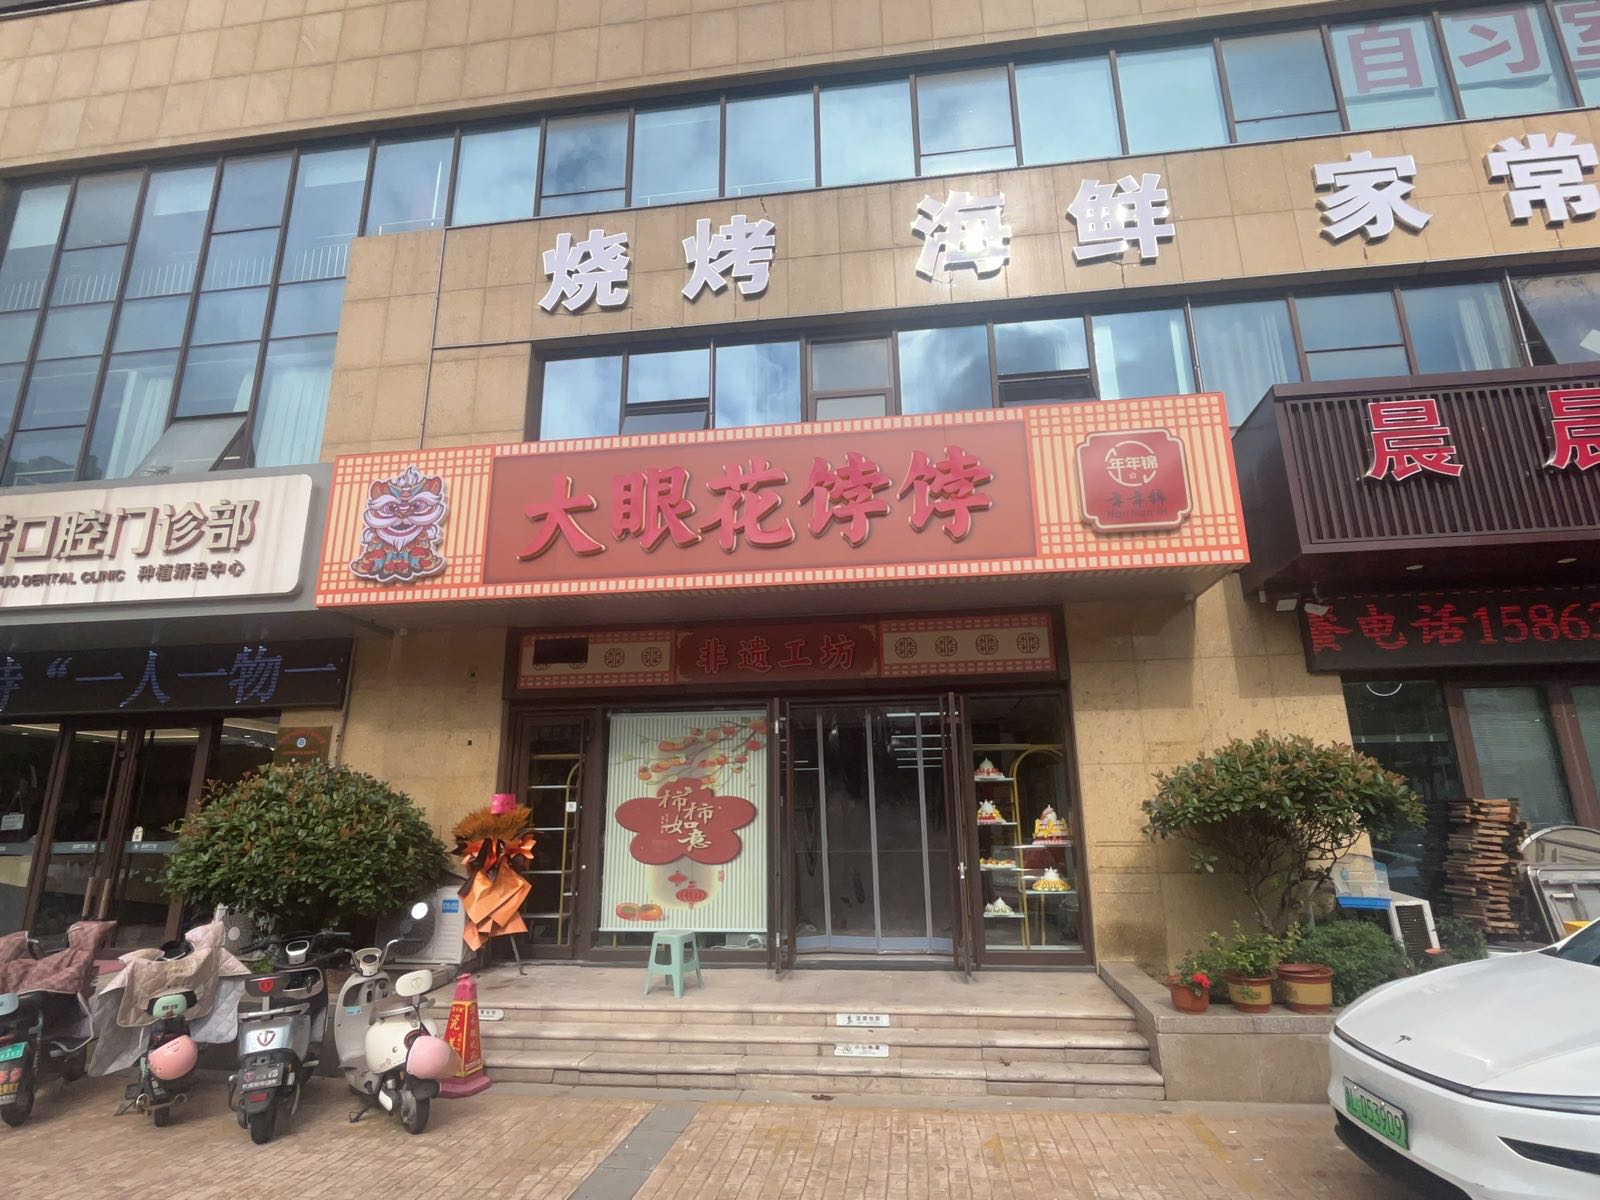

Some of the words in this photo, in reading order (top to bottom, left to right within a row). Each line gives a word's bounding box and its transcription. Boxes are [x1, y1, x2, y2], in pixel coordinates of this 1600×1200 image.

[538, 214, 776, 312] 烧烤
[910, 172, 1177, 280] 海鲜
[1311, 131, 1600, 243] 家常
[516, 444, 995, 561] 大眼花饽饽
[21, 572, 77, 588] DENTAL
[81, 569, 126, 584] CLINIC
[137, 559, 245, 583] 种植矫治中心
[696, 633, 856, 674] 非遗工坊
